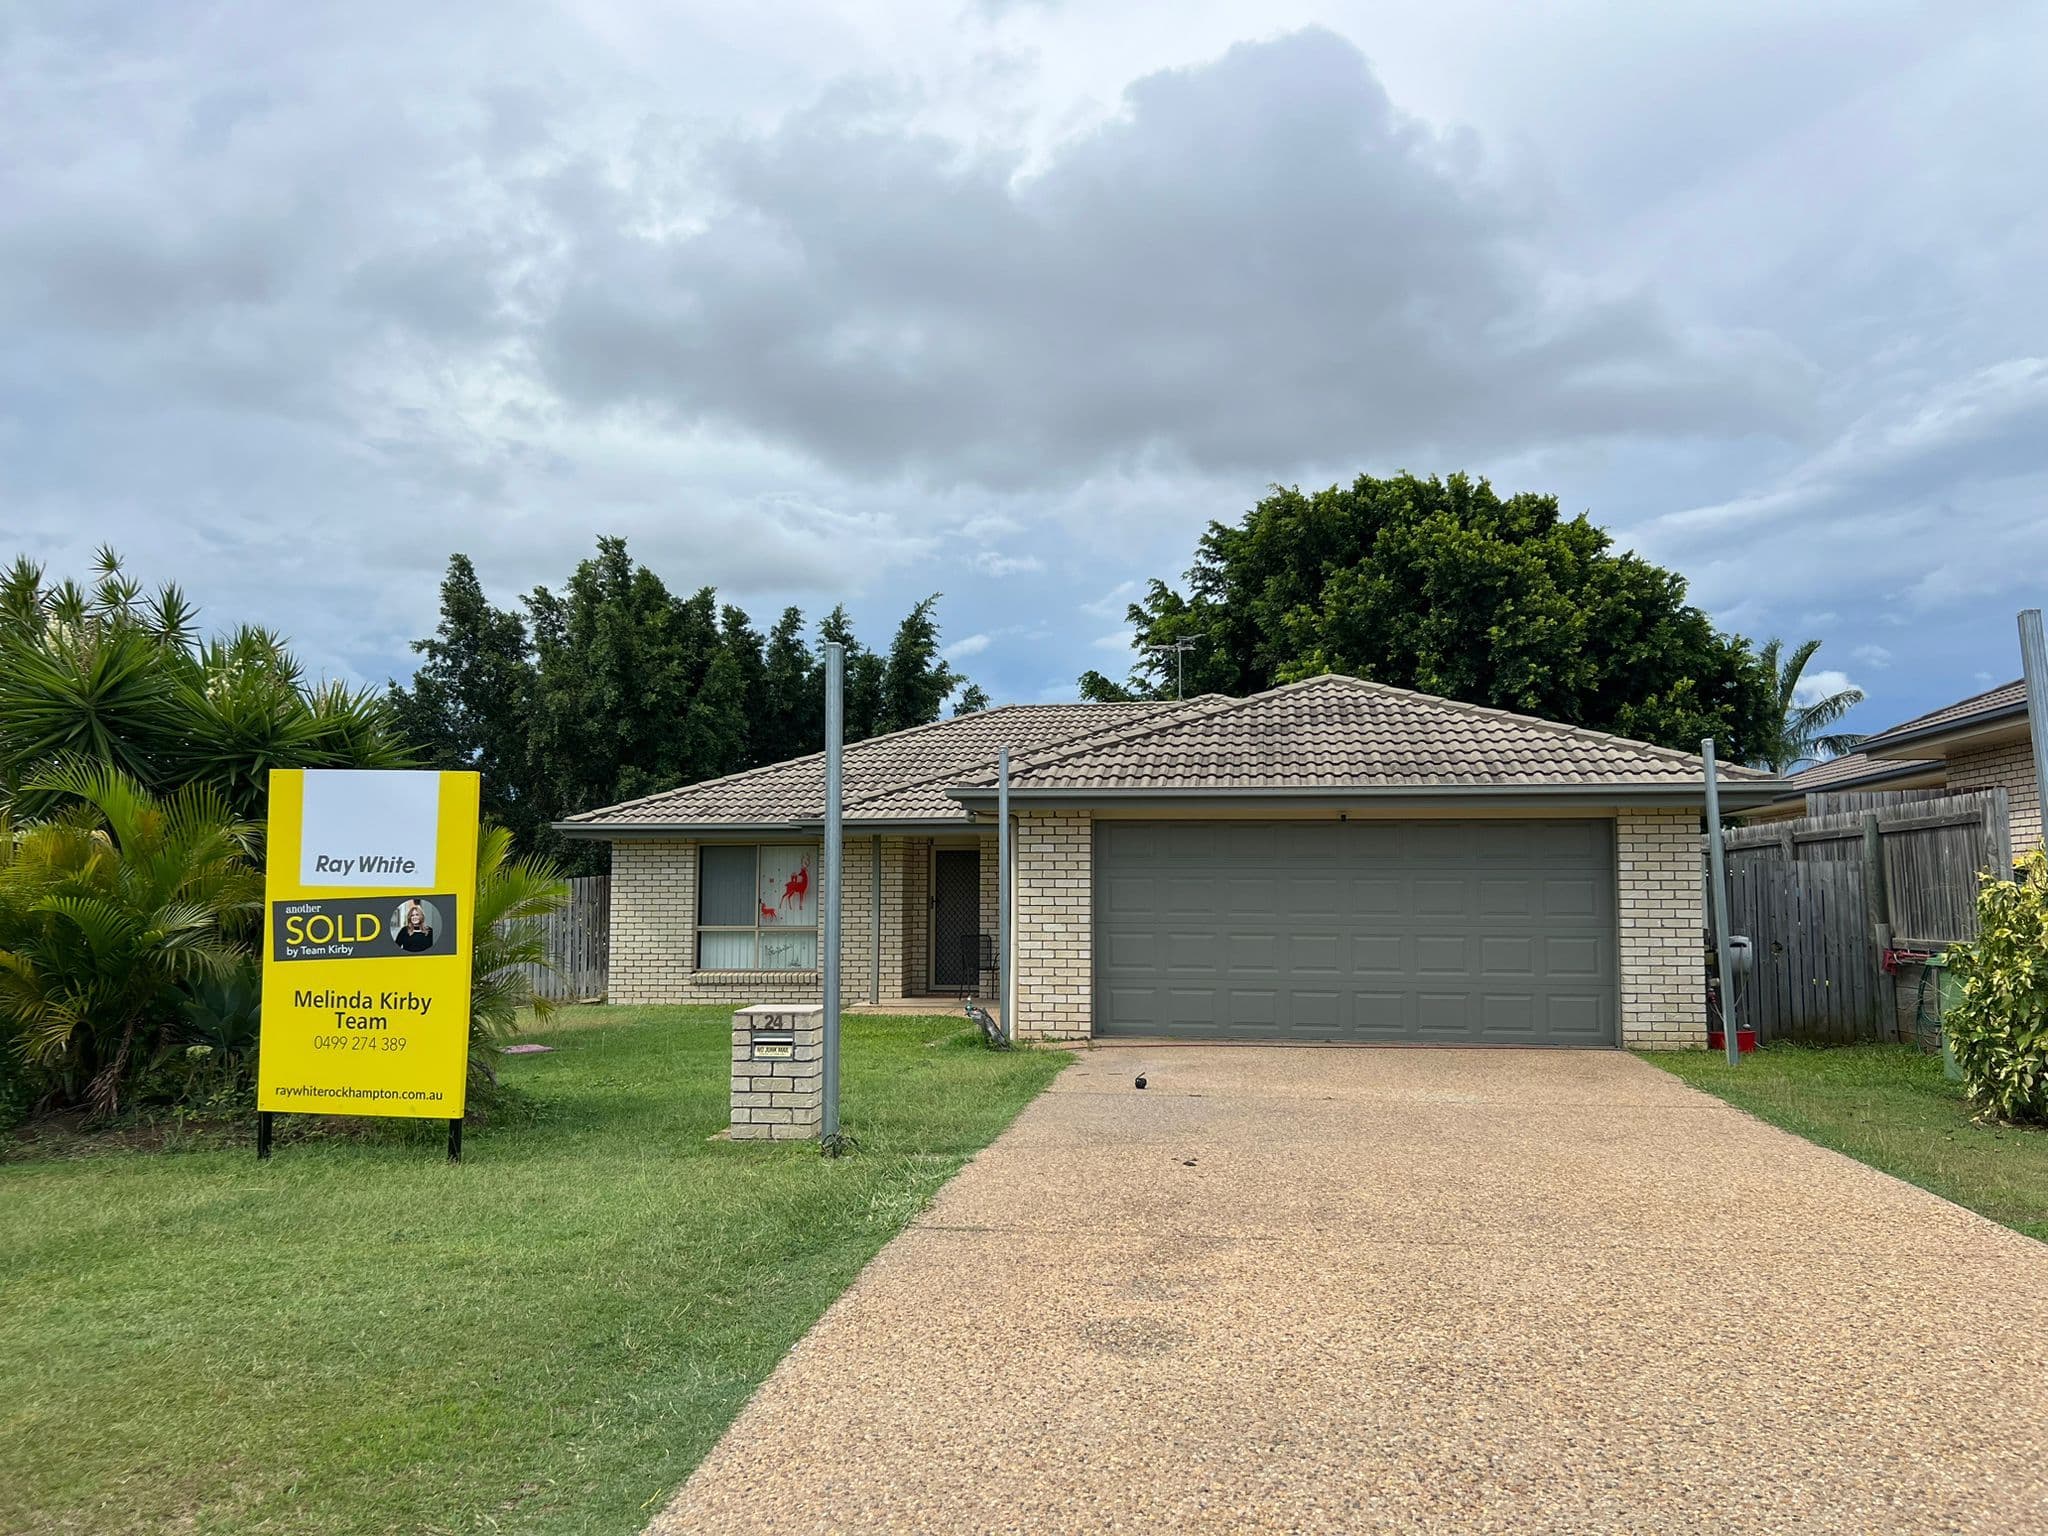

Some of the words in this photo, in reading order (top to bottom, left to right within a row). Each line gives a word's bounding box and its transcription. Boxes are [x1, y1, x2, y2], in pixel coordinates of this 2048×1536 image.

[315, 855, 355, 876] Ray
[358, 856, 416, 874] White
[285, 903, 322, 914] another
[285, 913, 382, 945] SOLD
[286, 946, 298, 958] by
[300, 945, 327, 955] Team
[328, 944, 354, 956] Kirby
[294, 990, 373, 1009] Melinda
[380, 992, 432, 1015] Kirby
[335, 1012, 388, 1030] Team
[764, 1014, 783, 1029] 24
[314, 1035, 348, 1050] 0499
[352, 1036, 376, 1051] 274
[381, 1037, 407, 1051] 389
[275, 1085, 443, 1101] raywhiterockhampton.com.au
